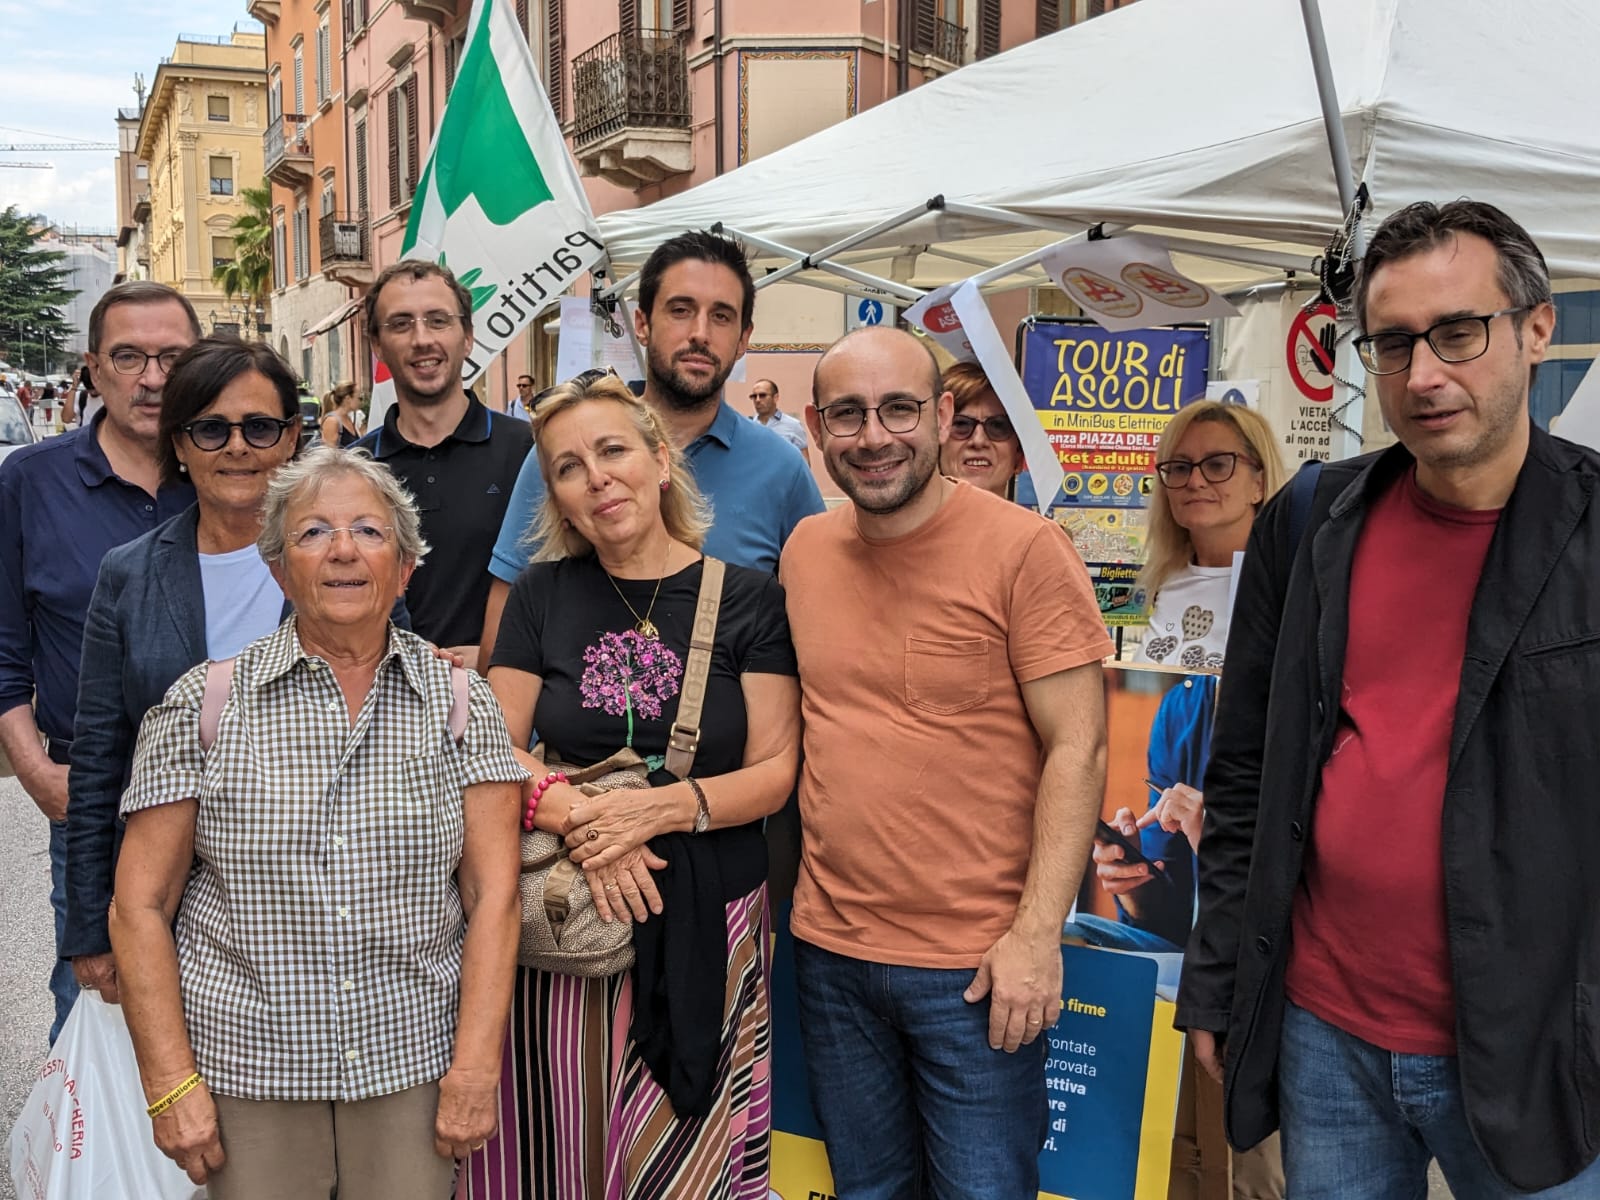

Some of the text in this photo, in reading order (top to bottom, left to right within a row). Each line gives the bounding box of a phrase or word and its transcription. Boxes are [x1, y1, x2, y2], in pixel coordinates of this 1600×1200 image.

[1054, 339, 1185, 377] TOUR di
[1050, 373, 1183, 410] ASCOLI
[1054, 414, 1064, 426] in
[1067, 413, 1115, 428] MiniBus
[1080, 432, 1124, 446] PIAZZA
[1127, 434, 1150, 446] DEL
[1298, 436, 1315, 444] non
[1093, 451, 1150, 466] adulti
[1067, 998, 1106, 1017] firme
[1052, 1118, 1067, 1133] di
